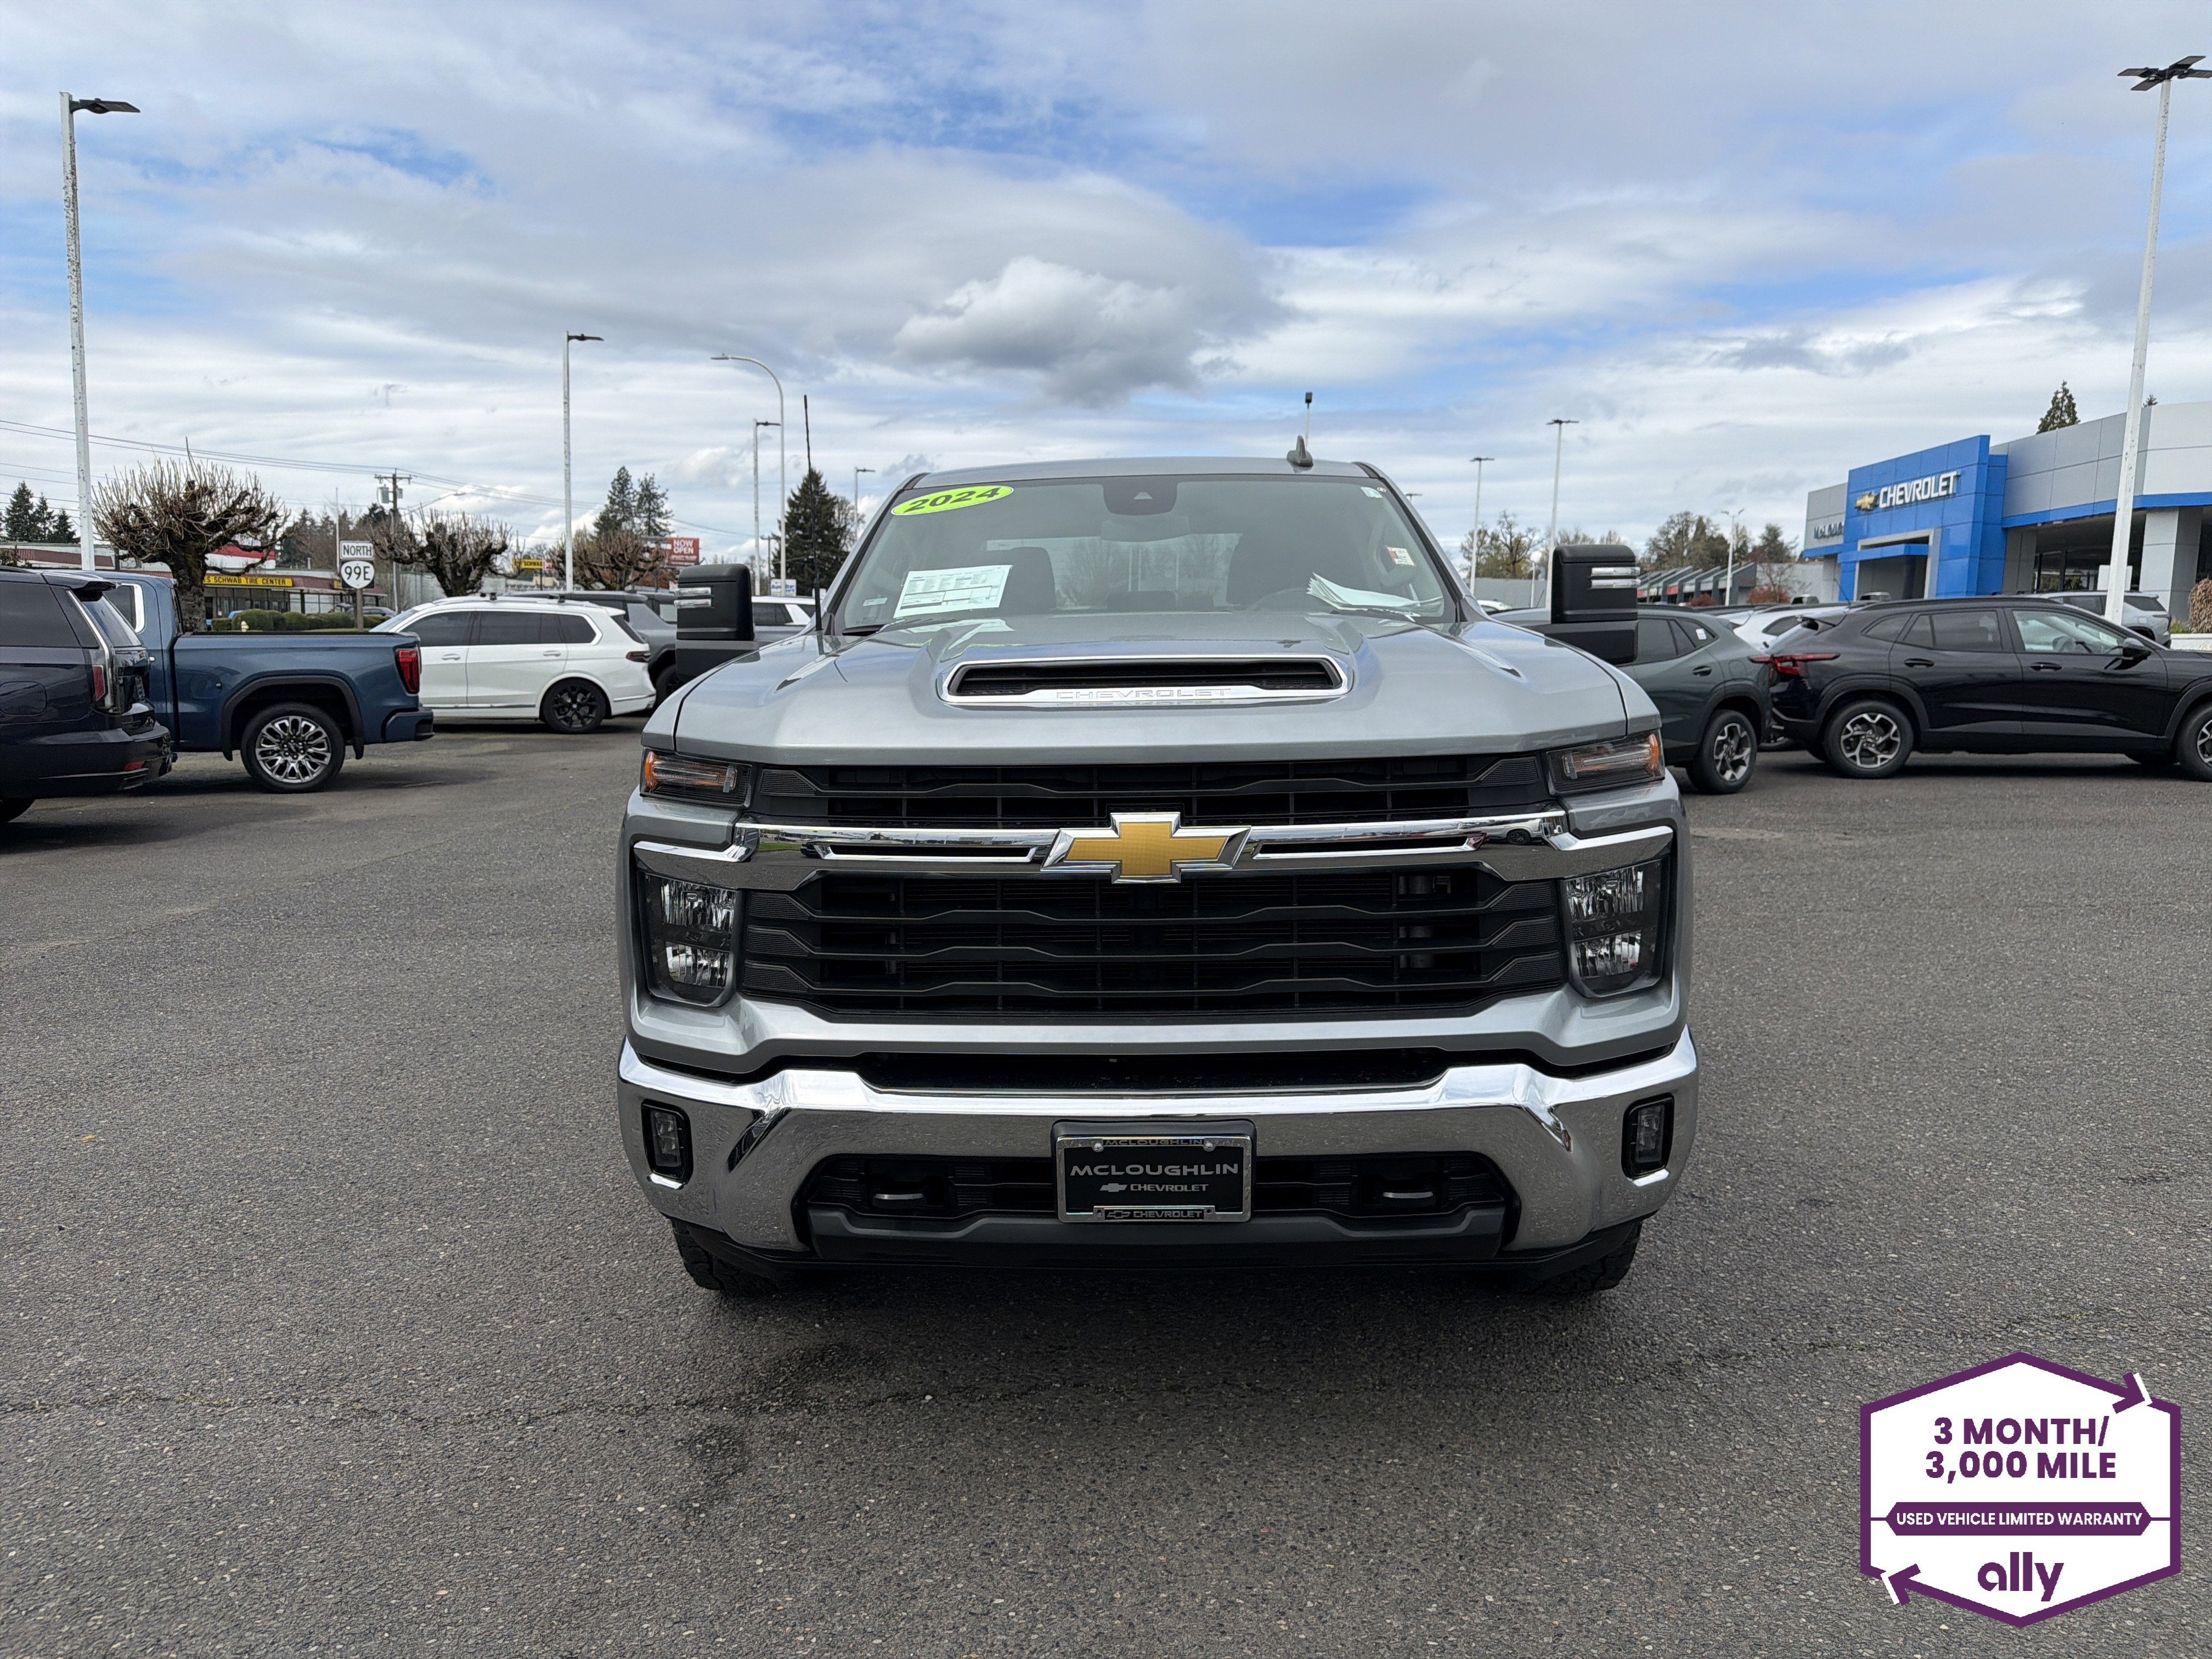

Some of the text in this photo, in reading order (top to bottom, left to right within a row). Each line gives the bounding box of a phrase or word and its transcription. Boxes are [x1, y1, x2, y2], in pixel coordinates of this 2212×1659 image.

[1878, 470, 1957, 509] CHEVROLET
[903, 486, 1002, 514] 2024
[673, 539, 693, 548] NOW
[343, 544, 372, 556] NORTH
[673, 546, 694, 555] OPEN
[344, 566, 371, 581] 99E
[1057, 688, 1232, 699] CHEVROLET
[1070, 1163, 1238, 1176] MCLOUGHLIN
[1130, 1183, 1209, 1192] CHEVROLET
[1133, 1210, 1203, 1218] CHEVROLET
